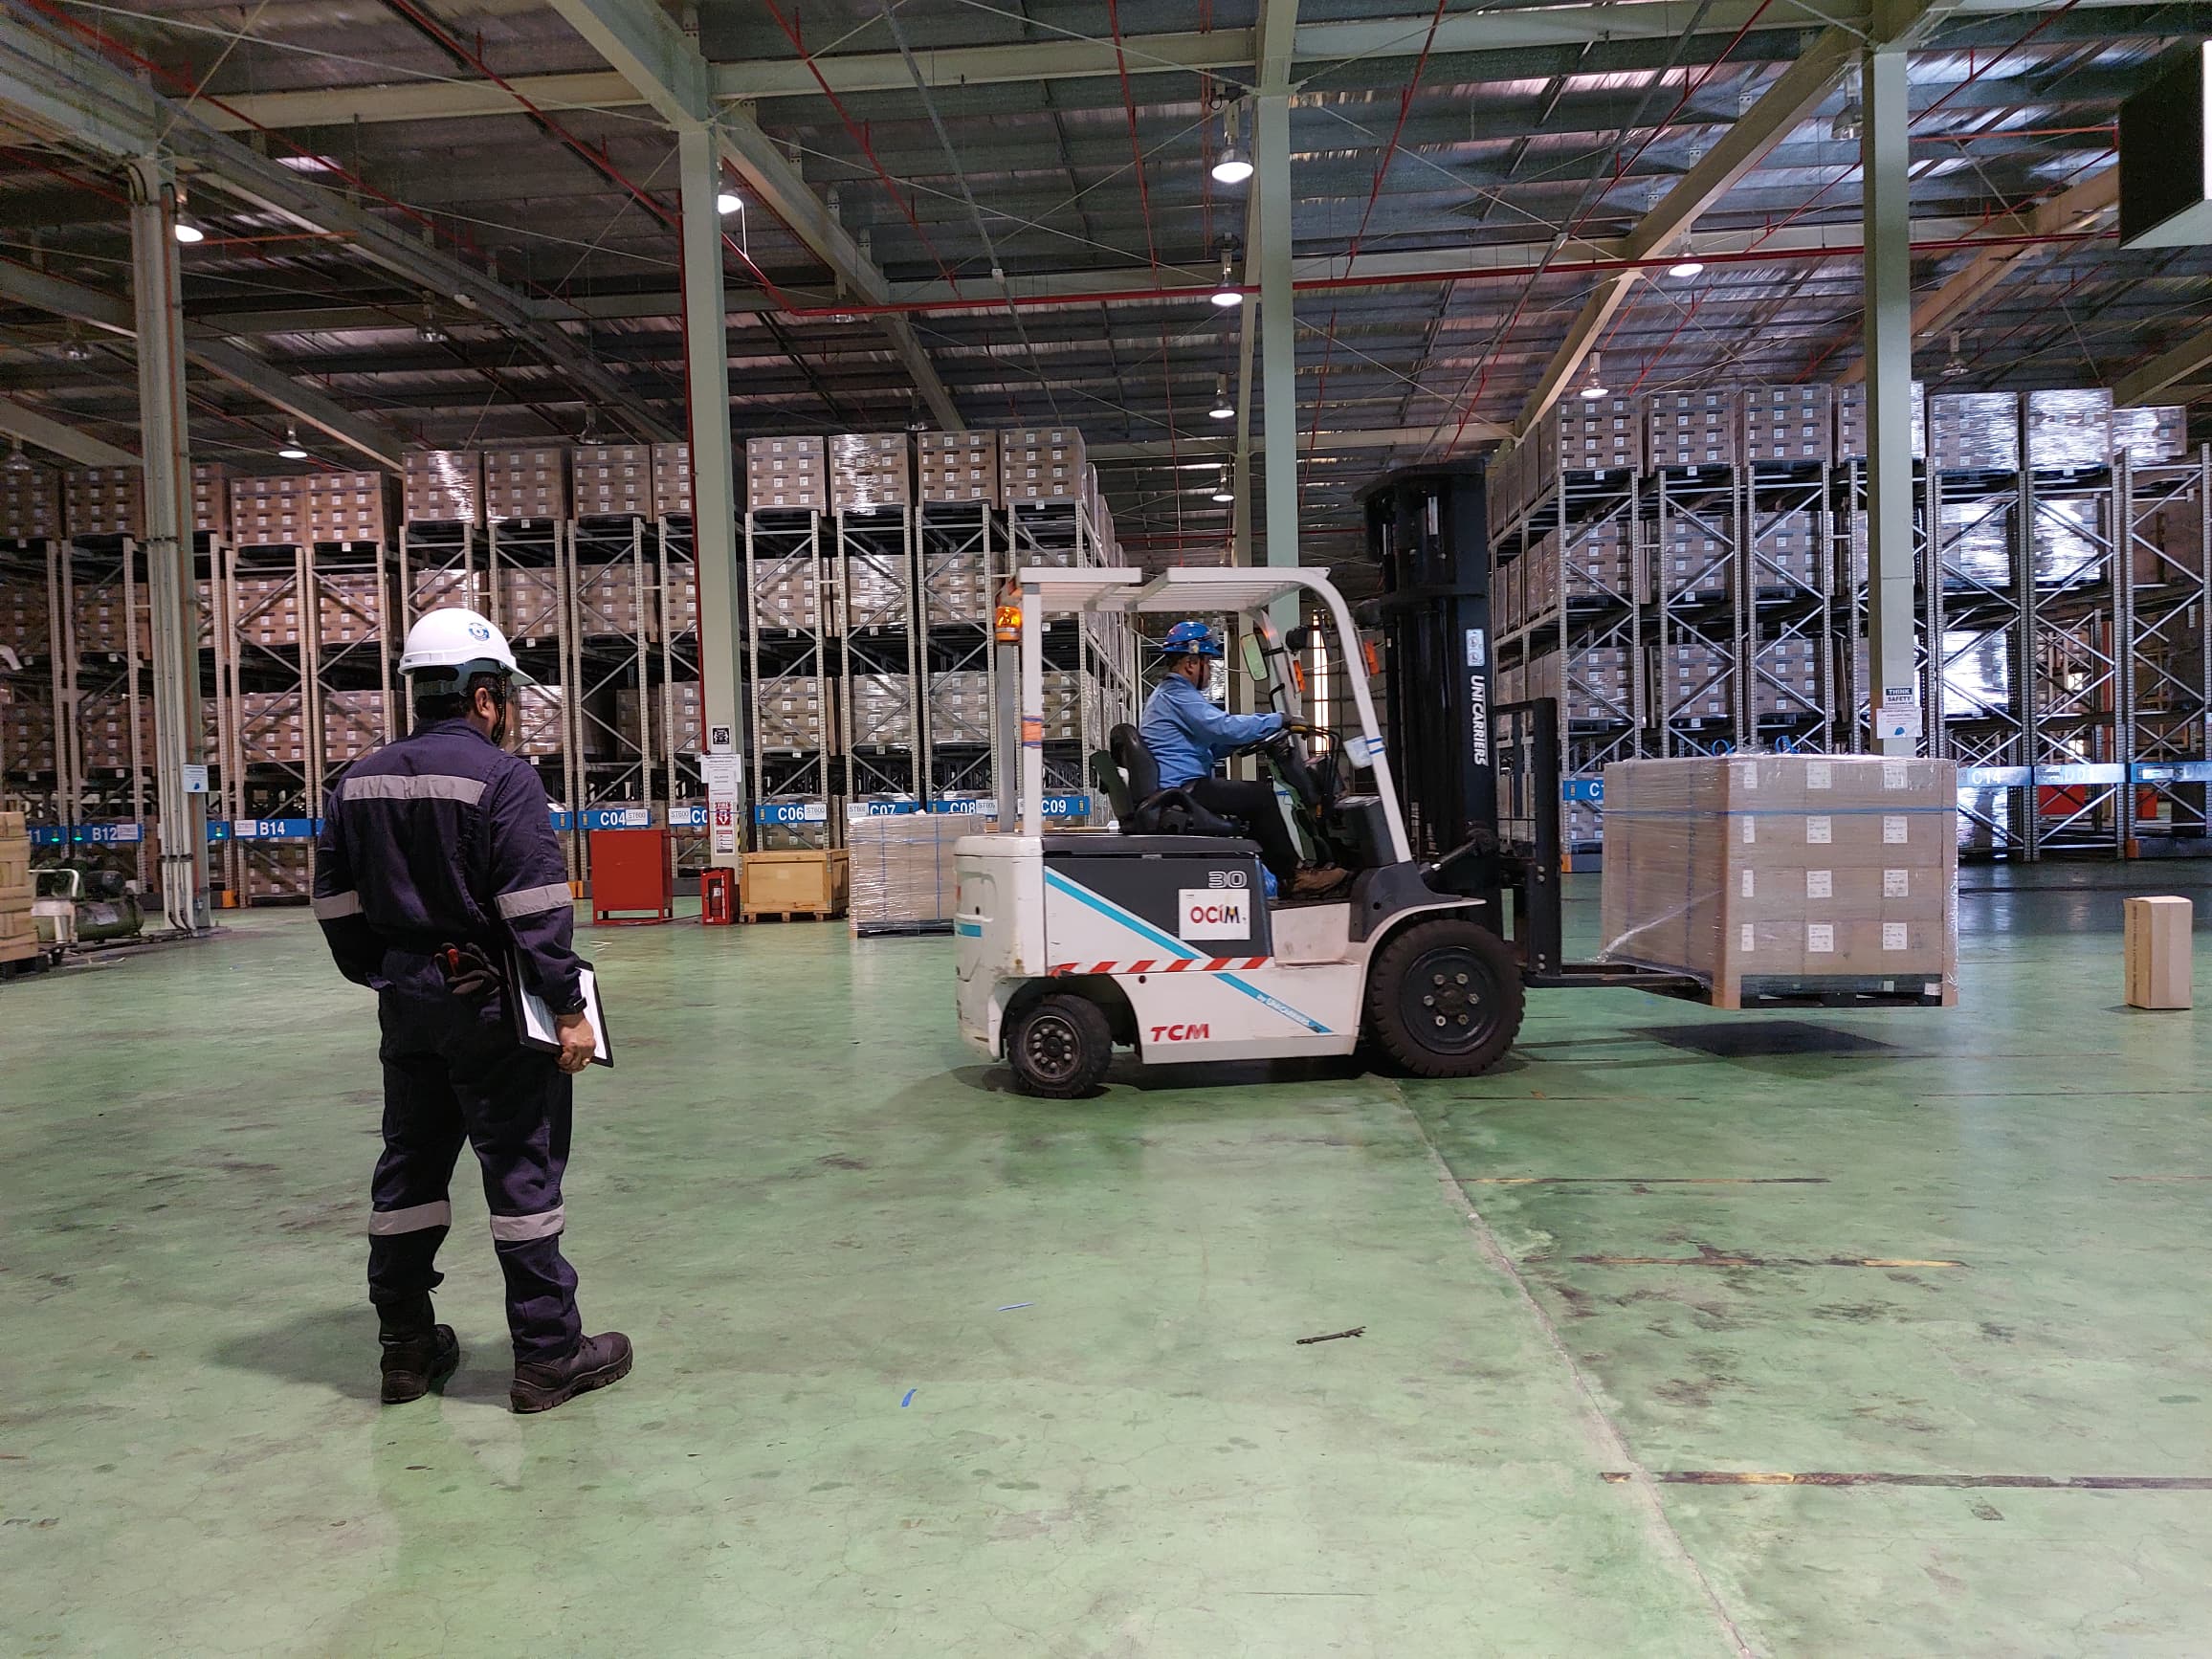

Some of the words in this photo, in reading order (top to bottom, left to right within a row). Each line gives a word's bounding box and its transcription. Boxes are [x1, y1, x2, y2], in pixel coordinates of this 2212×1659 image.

[1471, 675, 1489, 766] UNICARRIERS
[1972, 765, 2002, 781] C14
[1589, 783, 1604, 797] C
[870, 804, 896, 815] C07
[950, 802, 976, 814] C08
[1042, 800, 1067, 813] C09
[600, 811, 626, 826] C04
[778, 807, 804, 822] C06
[92, 827, 118, 842] B12
[259, 821, 286, 836] B14
[1208, 871, 1248, 889] 30
[1151, 1023, 1210, 1042] TCM
